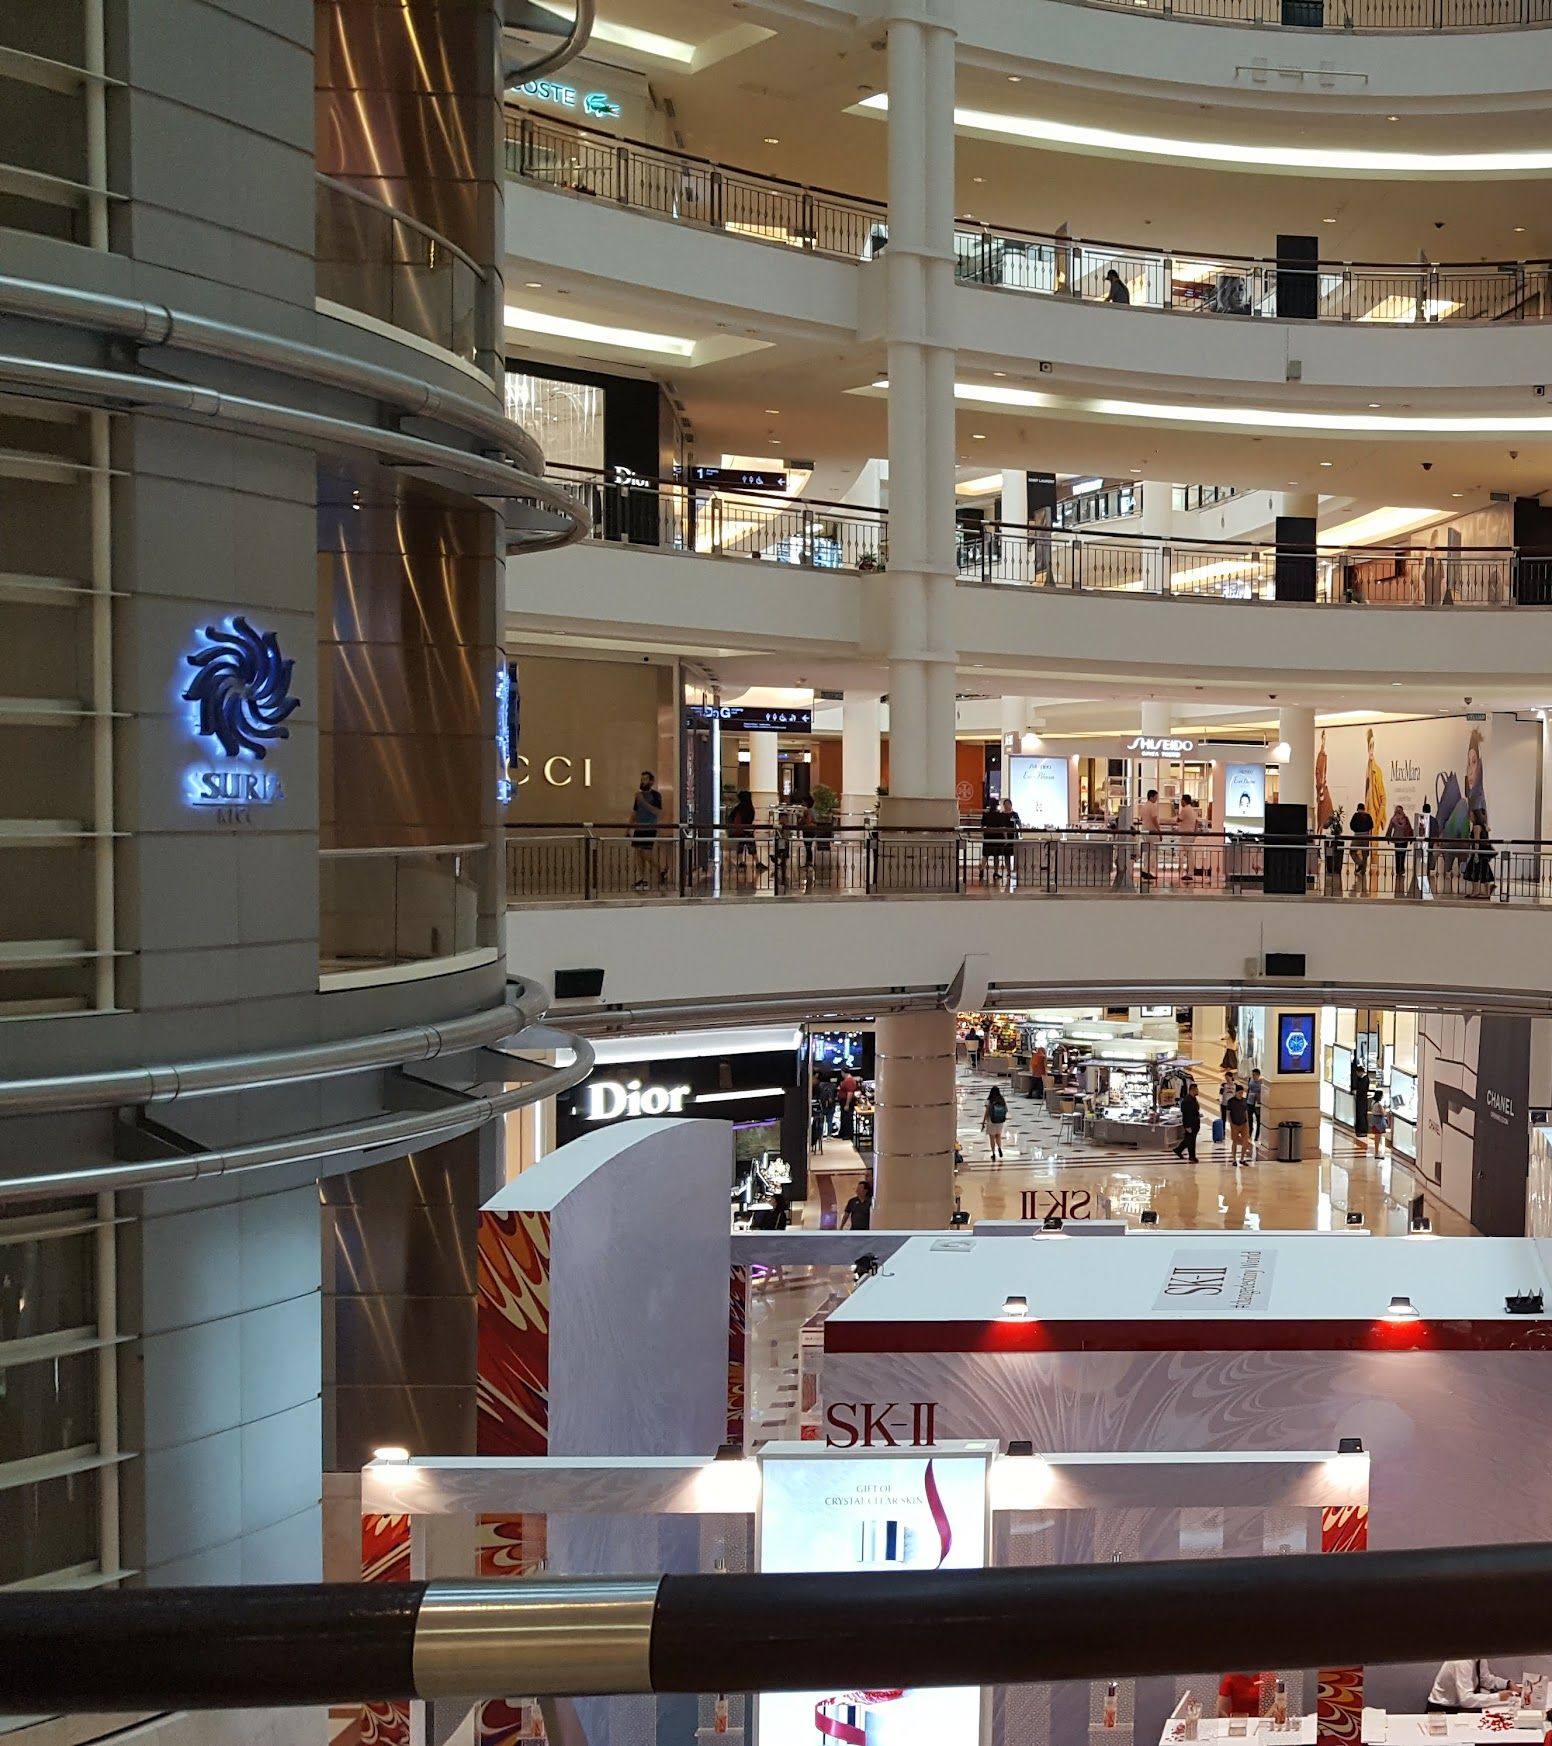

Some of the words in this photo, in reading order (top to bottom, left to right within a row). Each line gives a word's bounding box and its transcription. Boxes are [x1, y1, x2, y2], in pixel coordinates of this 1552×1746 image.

[697, 468, 704, 479] 1
[1127, 736, 1194, 751] SHISEIDO
[589, 1080, 690, 1120] Dior
[1486, 1090, 1515, 1117] CHANEL
[826, 1402, 939, 1448] SK-II
[856, 1484, 877, 1493] GIFT
[825, 1496, 864, 1506] CRYSTAL
[900, 1496, 923, 1505] SKIN
